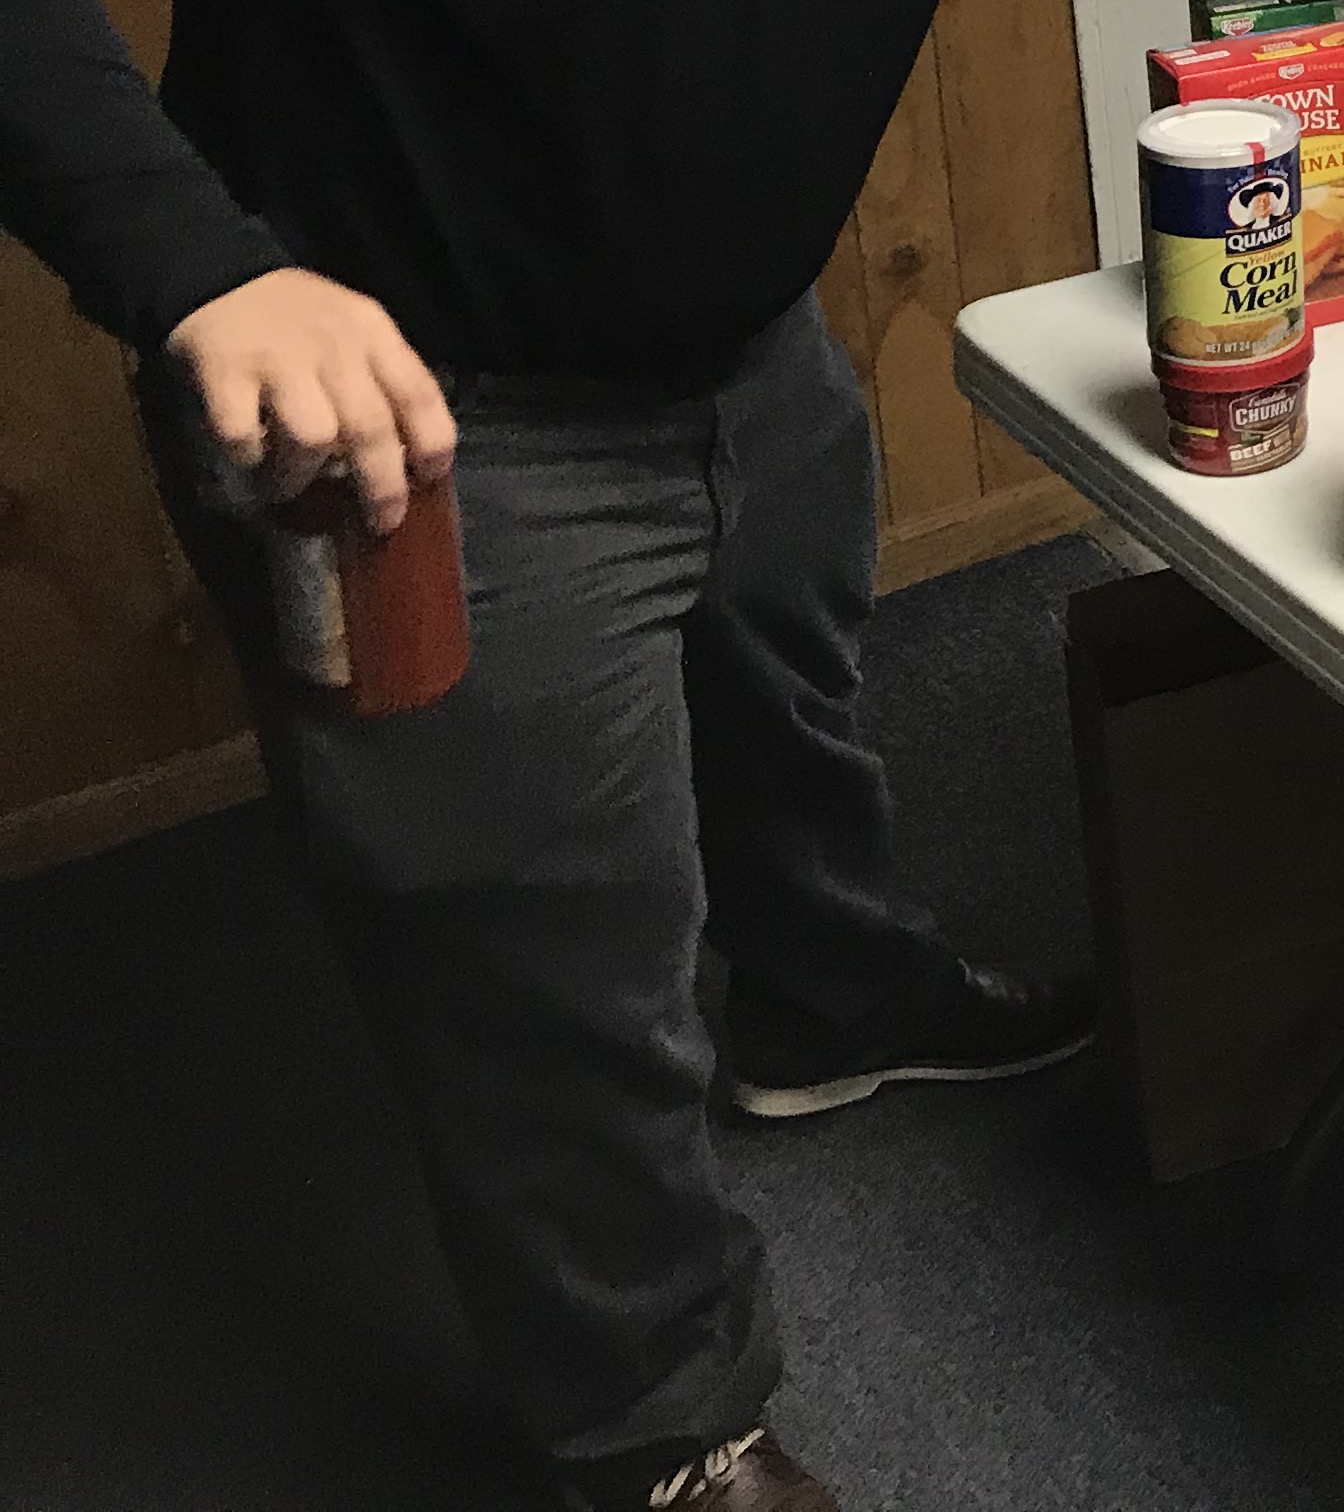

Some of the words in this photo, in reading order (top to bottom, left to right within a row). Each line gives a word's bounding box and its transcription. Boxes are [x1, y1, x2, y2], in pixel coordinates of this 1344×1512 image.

[1254, 84, 1335, 111] TOWN
[1299, 109, 1341, 131] USE
[1227, 221, 1293, 252] QUAKER
[1219, 251, 1297, 289] Corn
[1249, 249, 1286, 265] Yellow
[1222, 269, 1298, 315] Meal
[1205, 343, 1221, 354] NET
[1223, 342, 1238, 353] WT
[1239, 341, 1250, 352] 24
[1235, 394, 1298, 426] CHUNKY
[1229, 438, 1273, 462] BEEF
